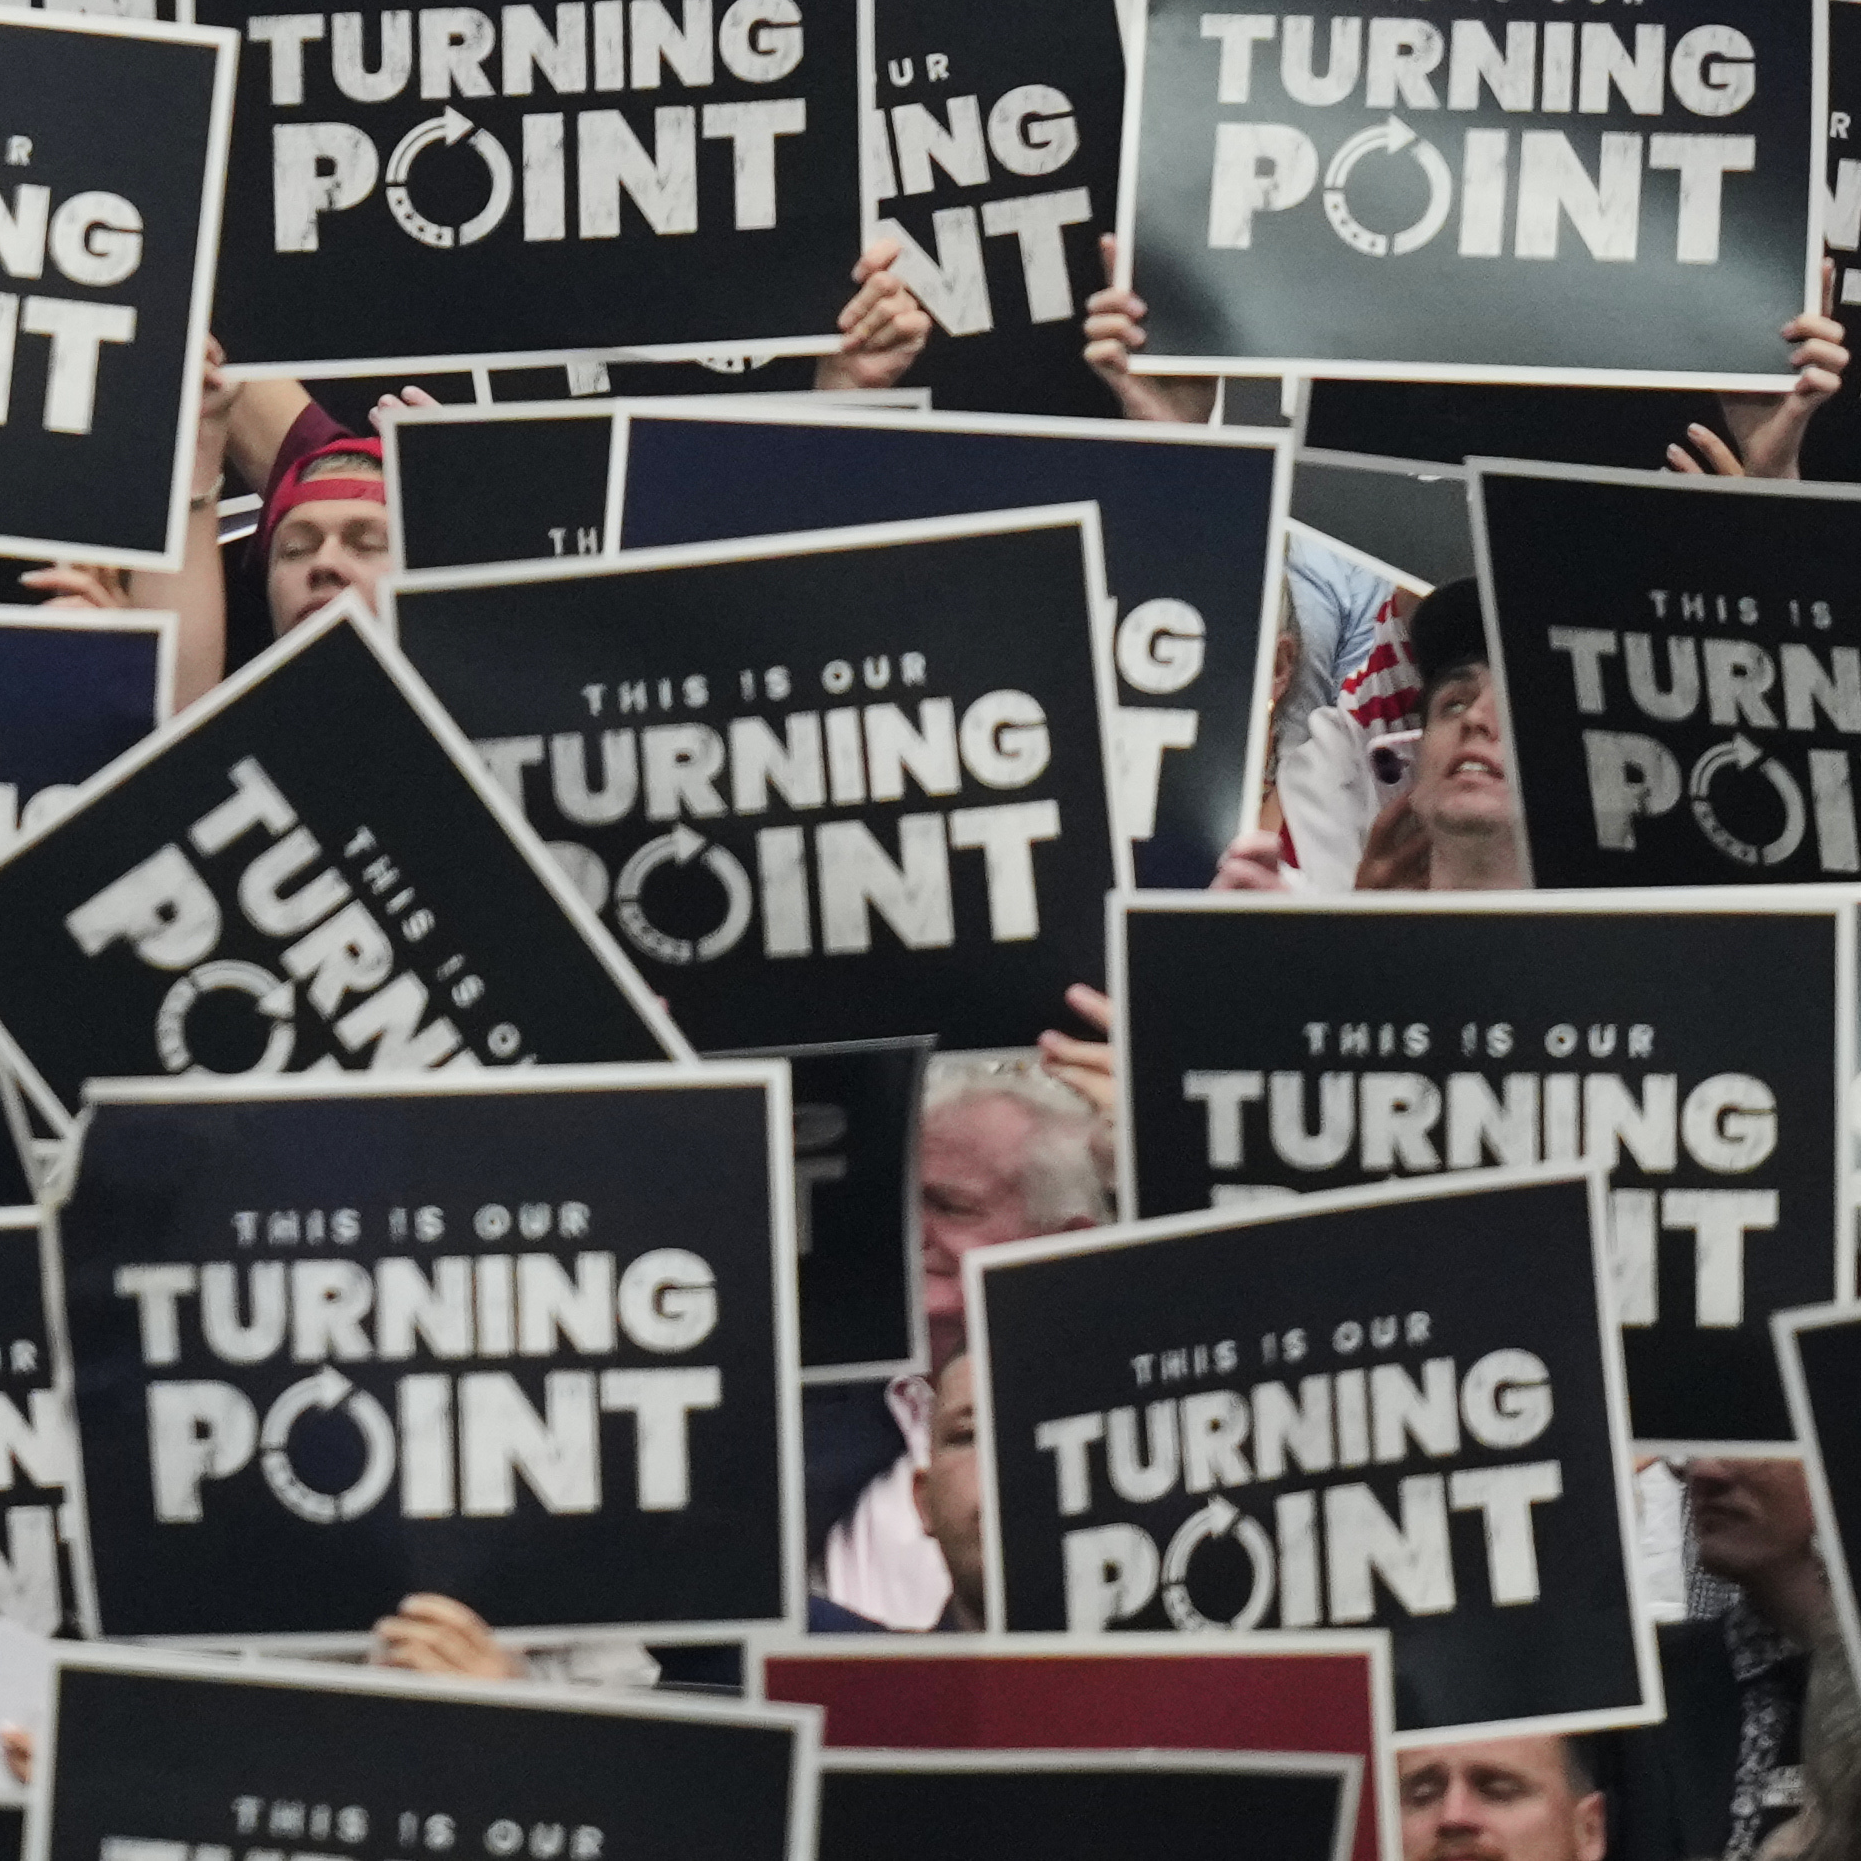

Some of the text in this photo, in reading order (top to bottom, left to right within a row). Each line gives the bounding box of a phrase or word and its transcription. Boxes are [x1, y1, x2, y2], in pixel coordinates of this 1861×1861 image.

[1191, 13, 1755, 124] TURNING
[273, 98, 806, 252] POINT
[1208, 115, 1754, 264] POINT
[1305, 1023, 1654, 1057] THIS IS OUR
[1185, 1072, 1777, 1181] TURNING
[235, 1202, 590, 1245] THIS IS OUR
[116, 1249, 717, 1363] TURNING
[1131, 1311, 1430, 1384] THIS IS OUR
[147, 1367, 720, 1521] POINT
[1036, 1341, 1560, 1523] TURNING
[1054, 1453, 1562, 1640] POINT
